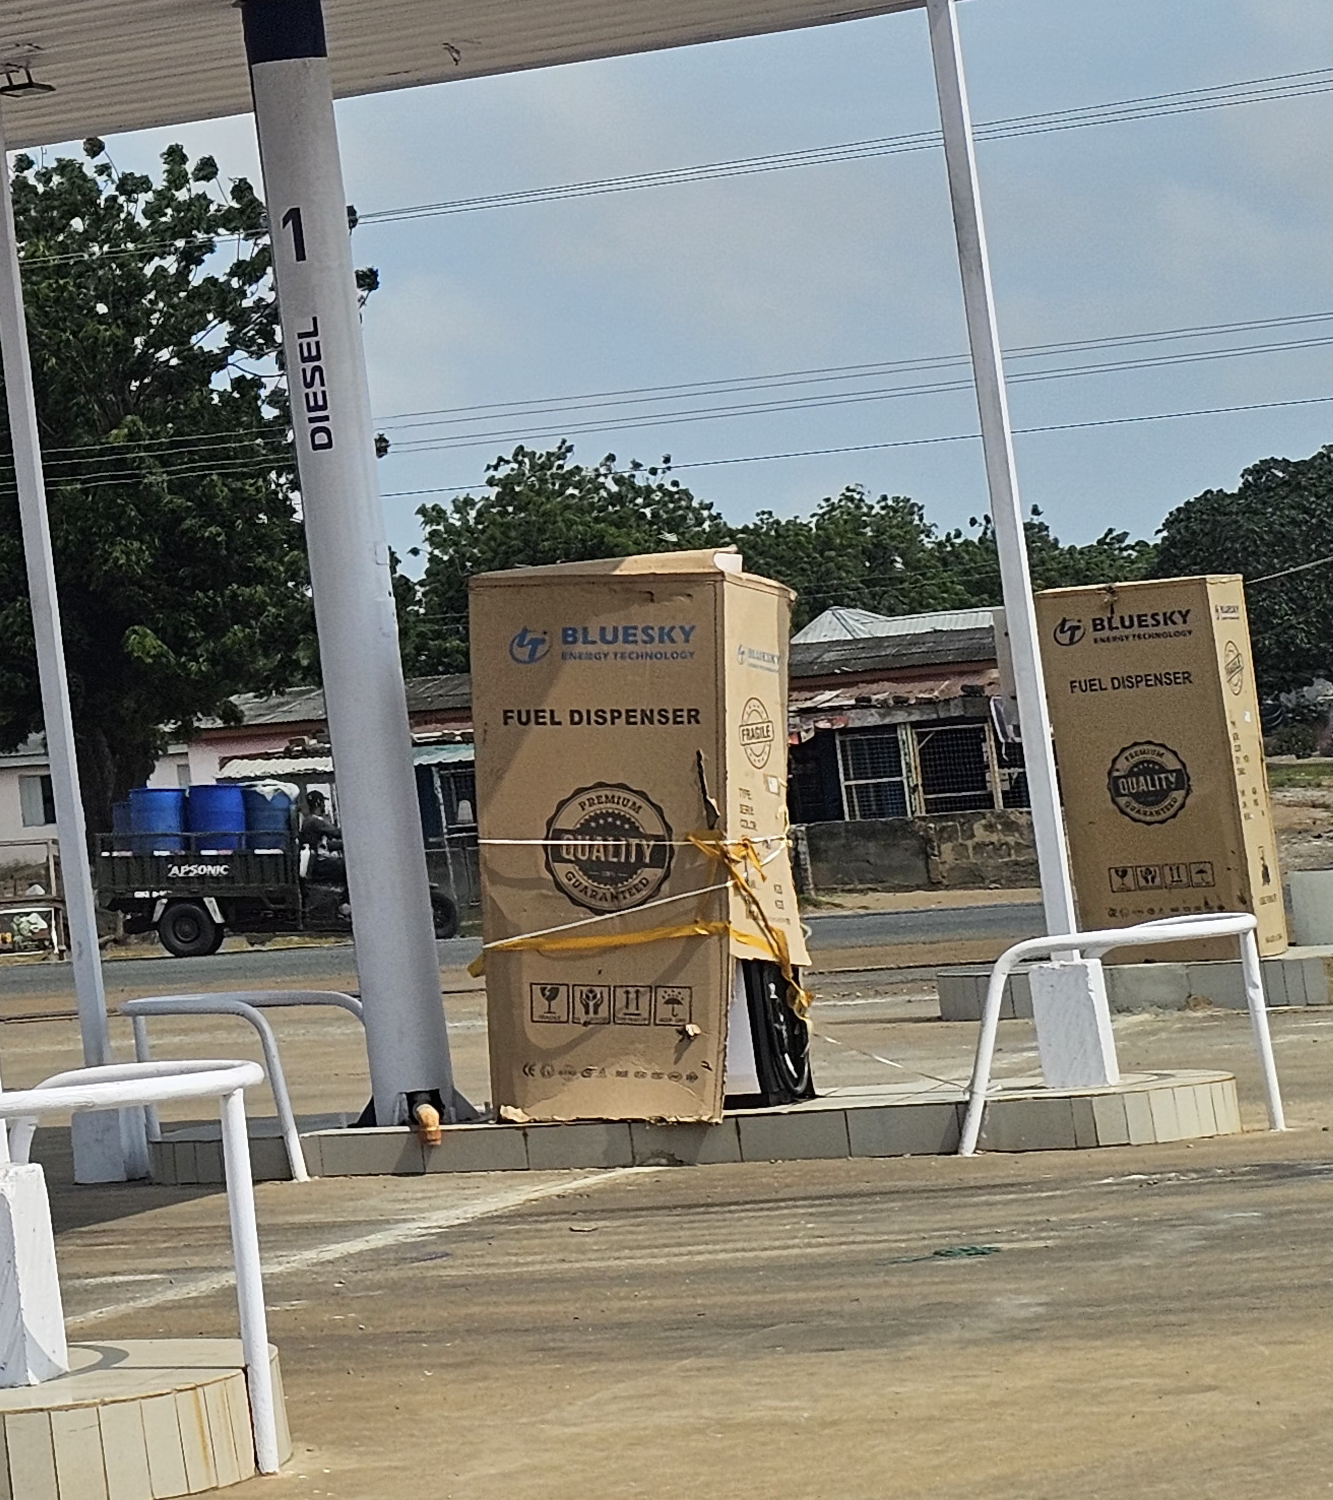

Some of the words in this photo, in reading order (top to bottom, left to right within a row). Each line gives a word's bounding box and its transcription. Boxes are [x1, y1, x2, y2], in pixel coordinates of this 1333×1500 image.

[282, 206, 307, 262] 1
[297, 316, 333, 452] DIESEL
[1092, 609, 1192, 632] BLUESKY
[561, 625, 696, 646] BLUESKY
[1093, 634, 1130, 645] ENERGY
[1132, 630, 1193, 642] TECHNOLOGY
[561, 650, 610, 662] ENERGY
[613, 650, 696, 661] TECHNOLOGY
[1069, 678, 1108, 694] FUEL
[1110, 671, 1193, 691] DISPENSER
[502, 708, 562, 726] FUEL
[569, 707, 702, 726] DISPENSER
[741, 724, 771, 742] FRAGILE
[1124, 747, 1165, 763] PREMIUM
[1118, 772, 1177, 795] QUALITY
[578, 794, 643, 814] PREMIUM
[1124, 796, 1179, 817] GUARANTEED
[560, 834, 655, 864] QUALITY
[167, 863, 230, 878] APSONIC
[565, 871, 650, 902] GUARANTEED
